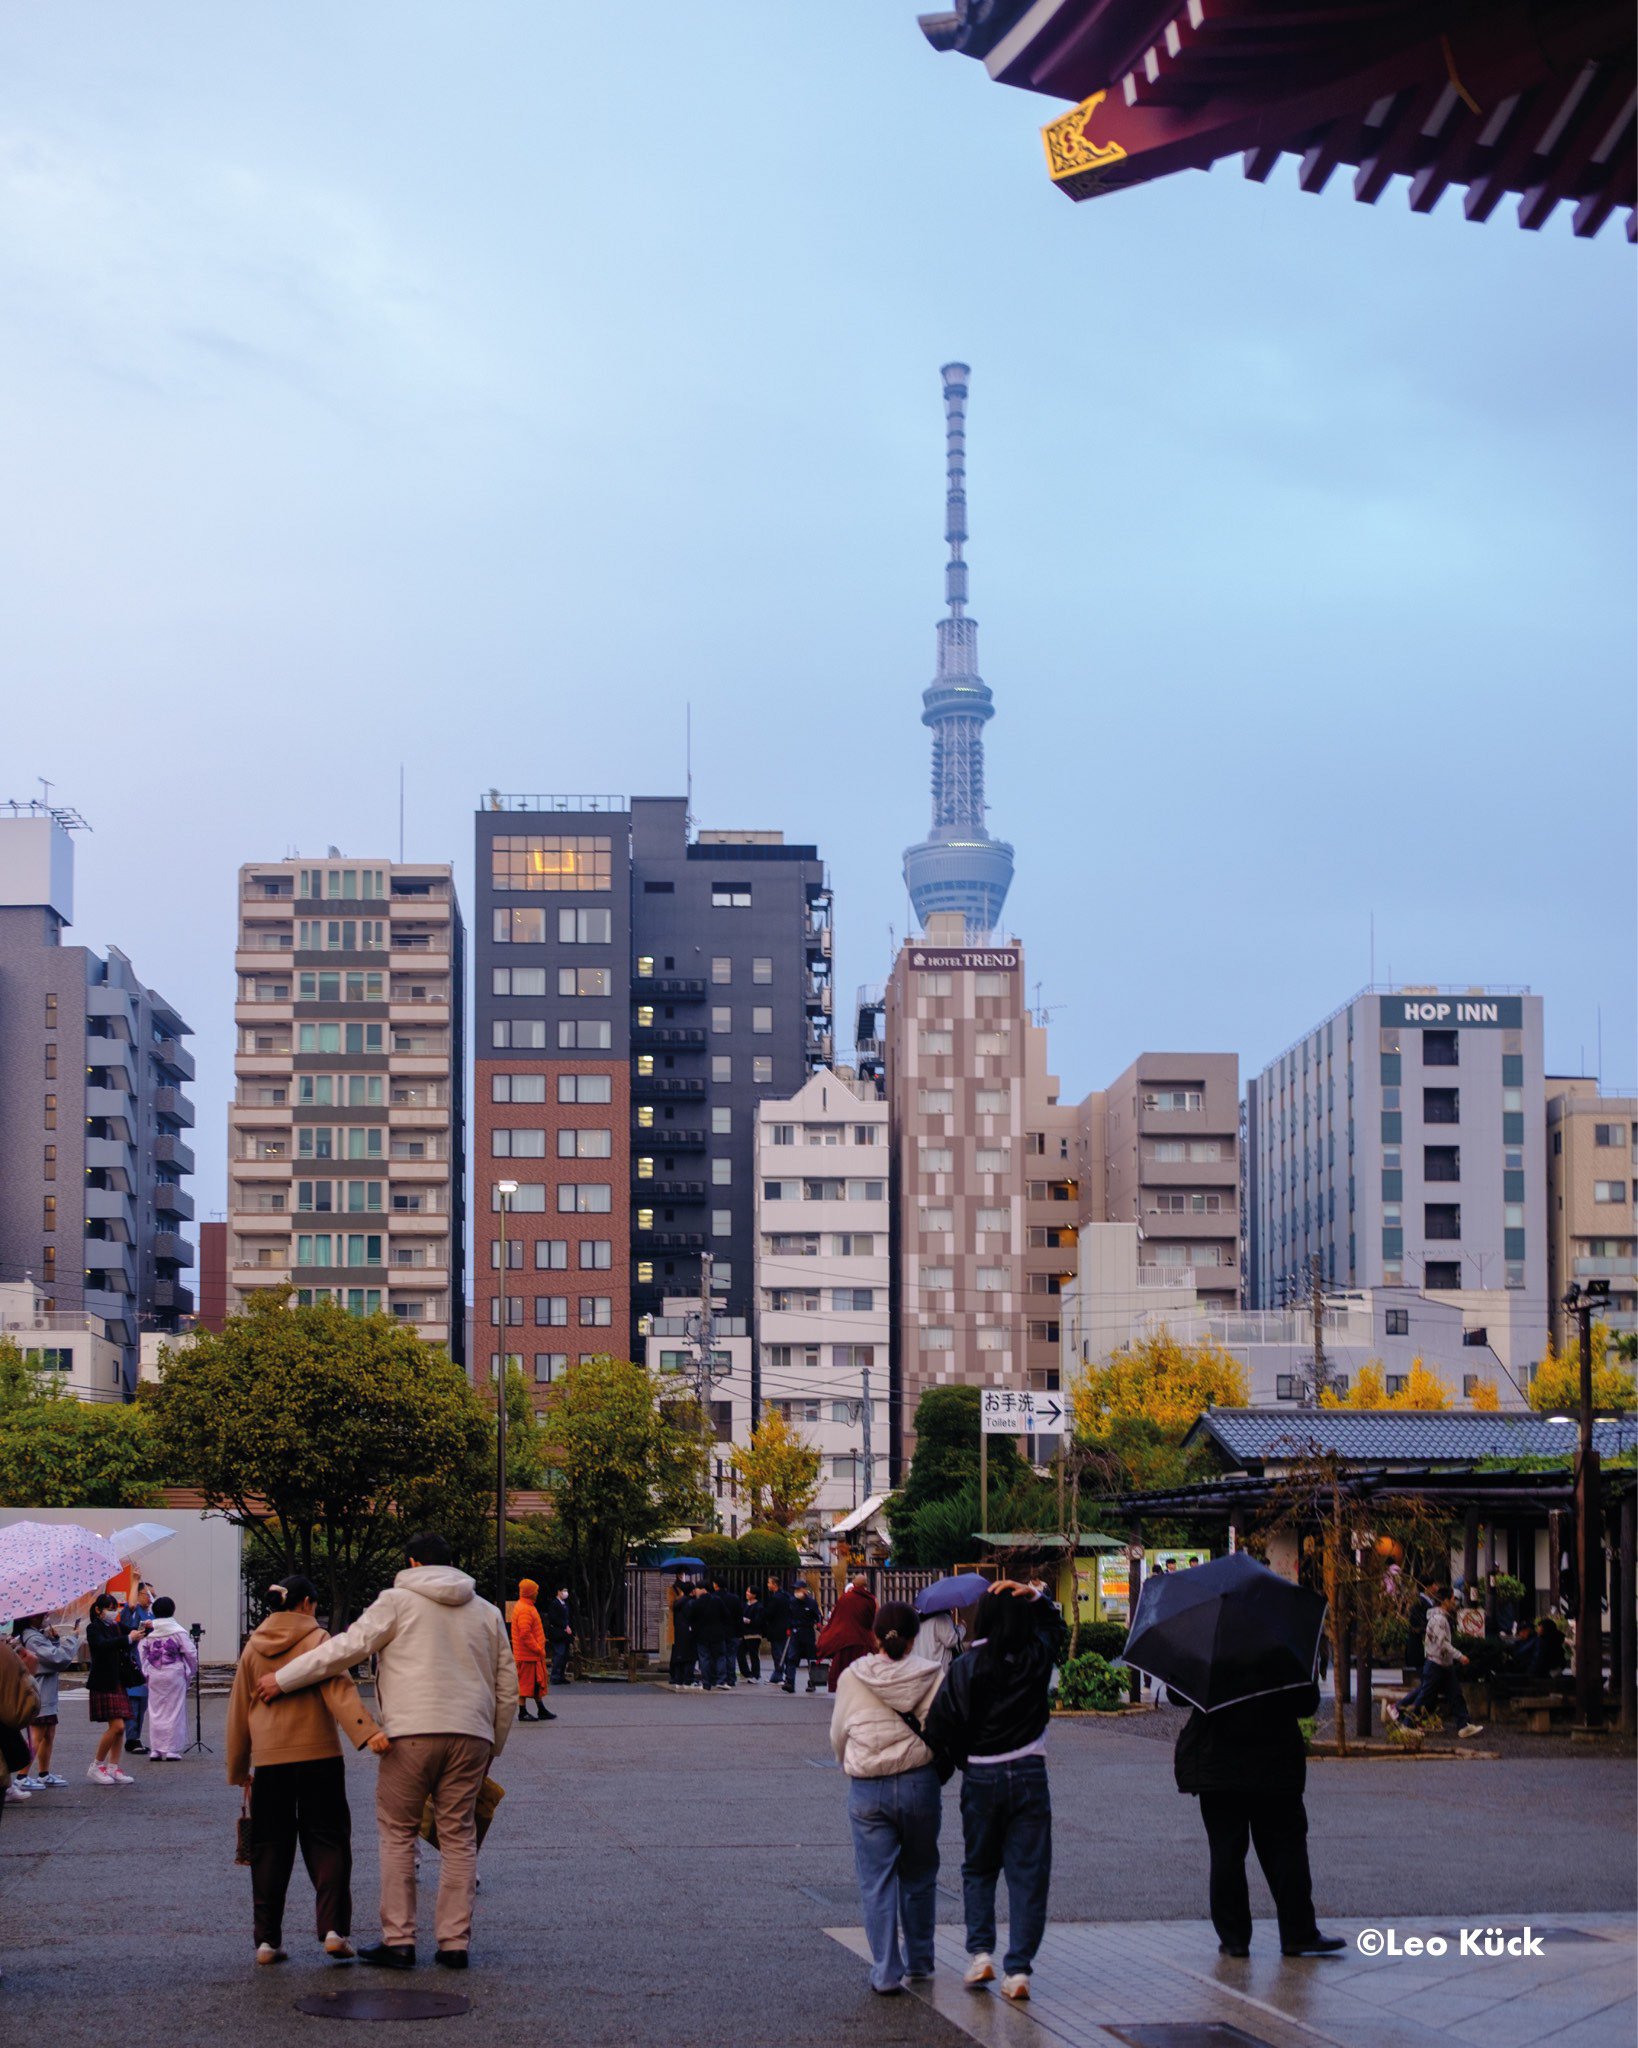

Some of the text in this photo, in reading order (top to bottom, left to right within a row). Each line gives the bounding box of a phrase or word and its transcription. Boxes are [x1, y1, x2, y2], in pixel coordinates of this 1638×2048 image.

[928, 953, 1017, 967] HOTEL TREND
[1404, 1003, 1498, 1022] HOP INN
[984, 1392, 1034, 1412] お手洗
[986, 1417, 1017, 1428] Toilets
